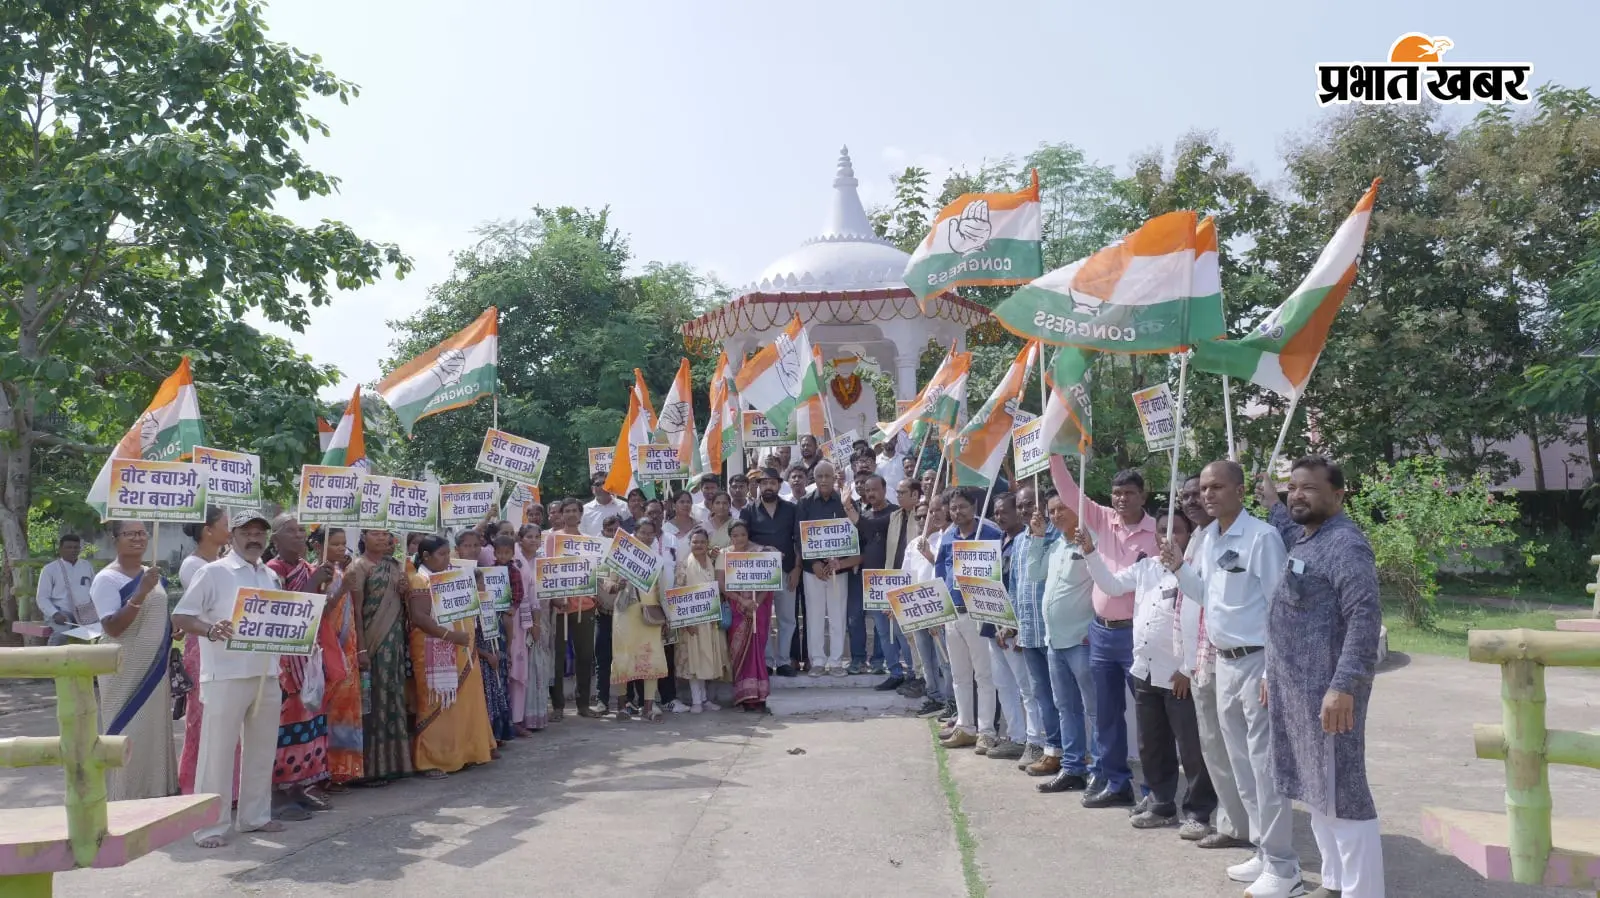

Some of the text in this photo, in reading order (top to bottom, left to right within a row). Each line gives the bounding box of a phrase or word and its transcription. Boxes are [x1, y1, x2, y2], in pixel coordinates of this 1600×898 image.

[491, 436, 509, 451] वोट
[646, 447, 661, 458] वोट
[220, 458, 255, 478] बचाओ,
[487, 449, 535, 473] देश बचाओ
[120, 465, 201, 489] वोट बचाओ,
[308, 471, 359, 492] वोट बचाओ,
[220, 478, 253, 494] बचाओ
[408, 484, 429, 503] चोर,
[118, 486, 145, 505] देश
[148, 489, 196, 507] बचाओ
[306, 491, 355, 509] देश बचाओ
[408, 502, 428, 520] छोड़
[453, 504, 465, 514] देश
[807, 525, 821, 536] वोट
[564, 538, 581, 550] वोट
[619, 536, 633, 552] वोट
[807, 535, 852, 549] देश बचाओ
[542, 561, 559, 574] वोट
[613, 547, 627, 564] देश
[626, 558, 651, 580] बचाओ
[961, 563, 972, 575] देश
[542, 573, 590, 588] देश बचाओ
[736, 569, 772, 581] देश बचाओ
[868, 573, 912, 586] वोट बचाओ
[868, 588, 884, 600] देश
[896, 591, 916, 604] वोट
[243, 594, 316, 621] वोट बचाओ,
[676, 601, 711, 616] देश बचाओ
[903, 603, 924, 618] गद्दी
[238, 616, 308, 640] देश बचाओ
